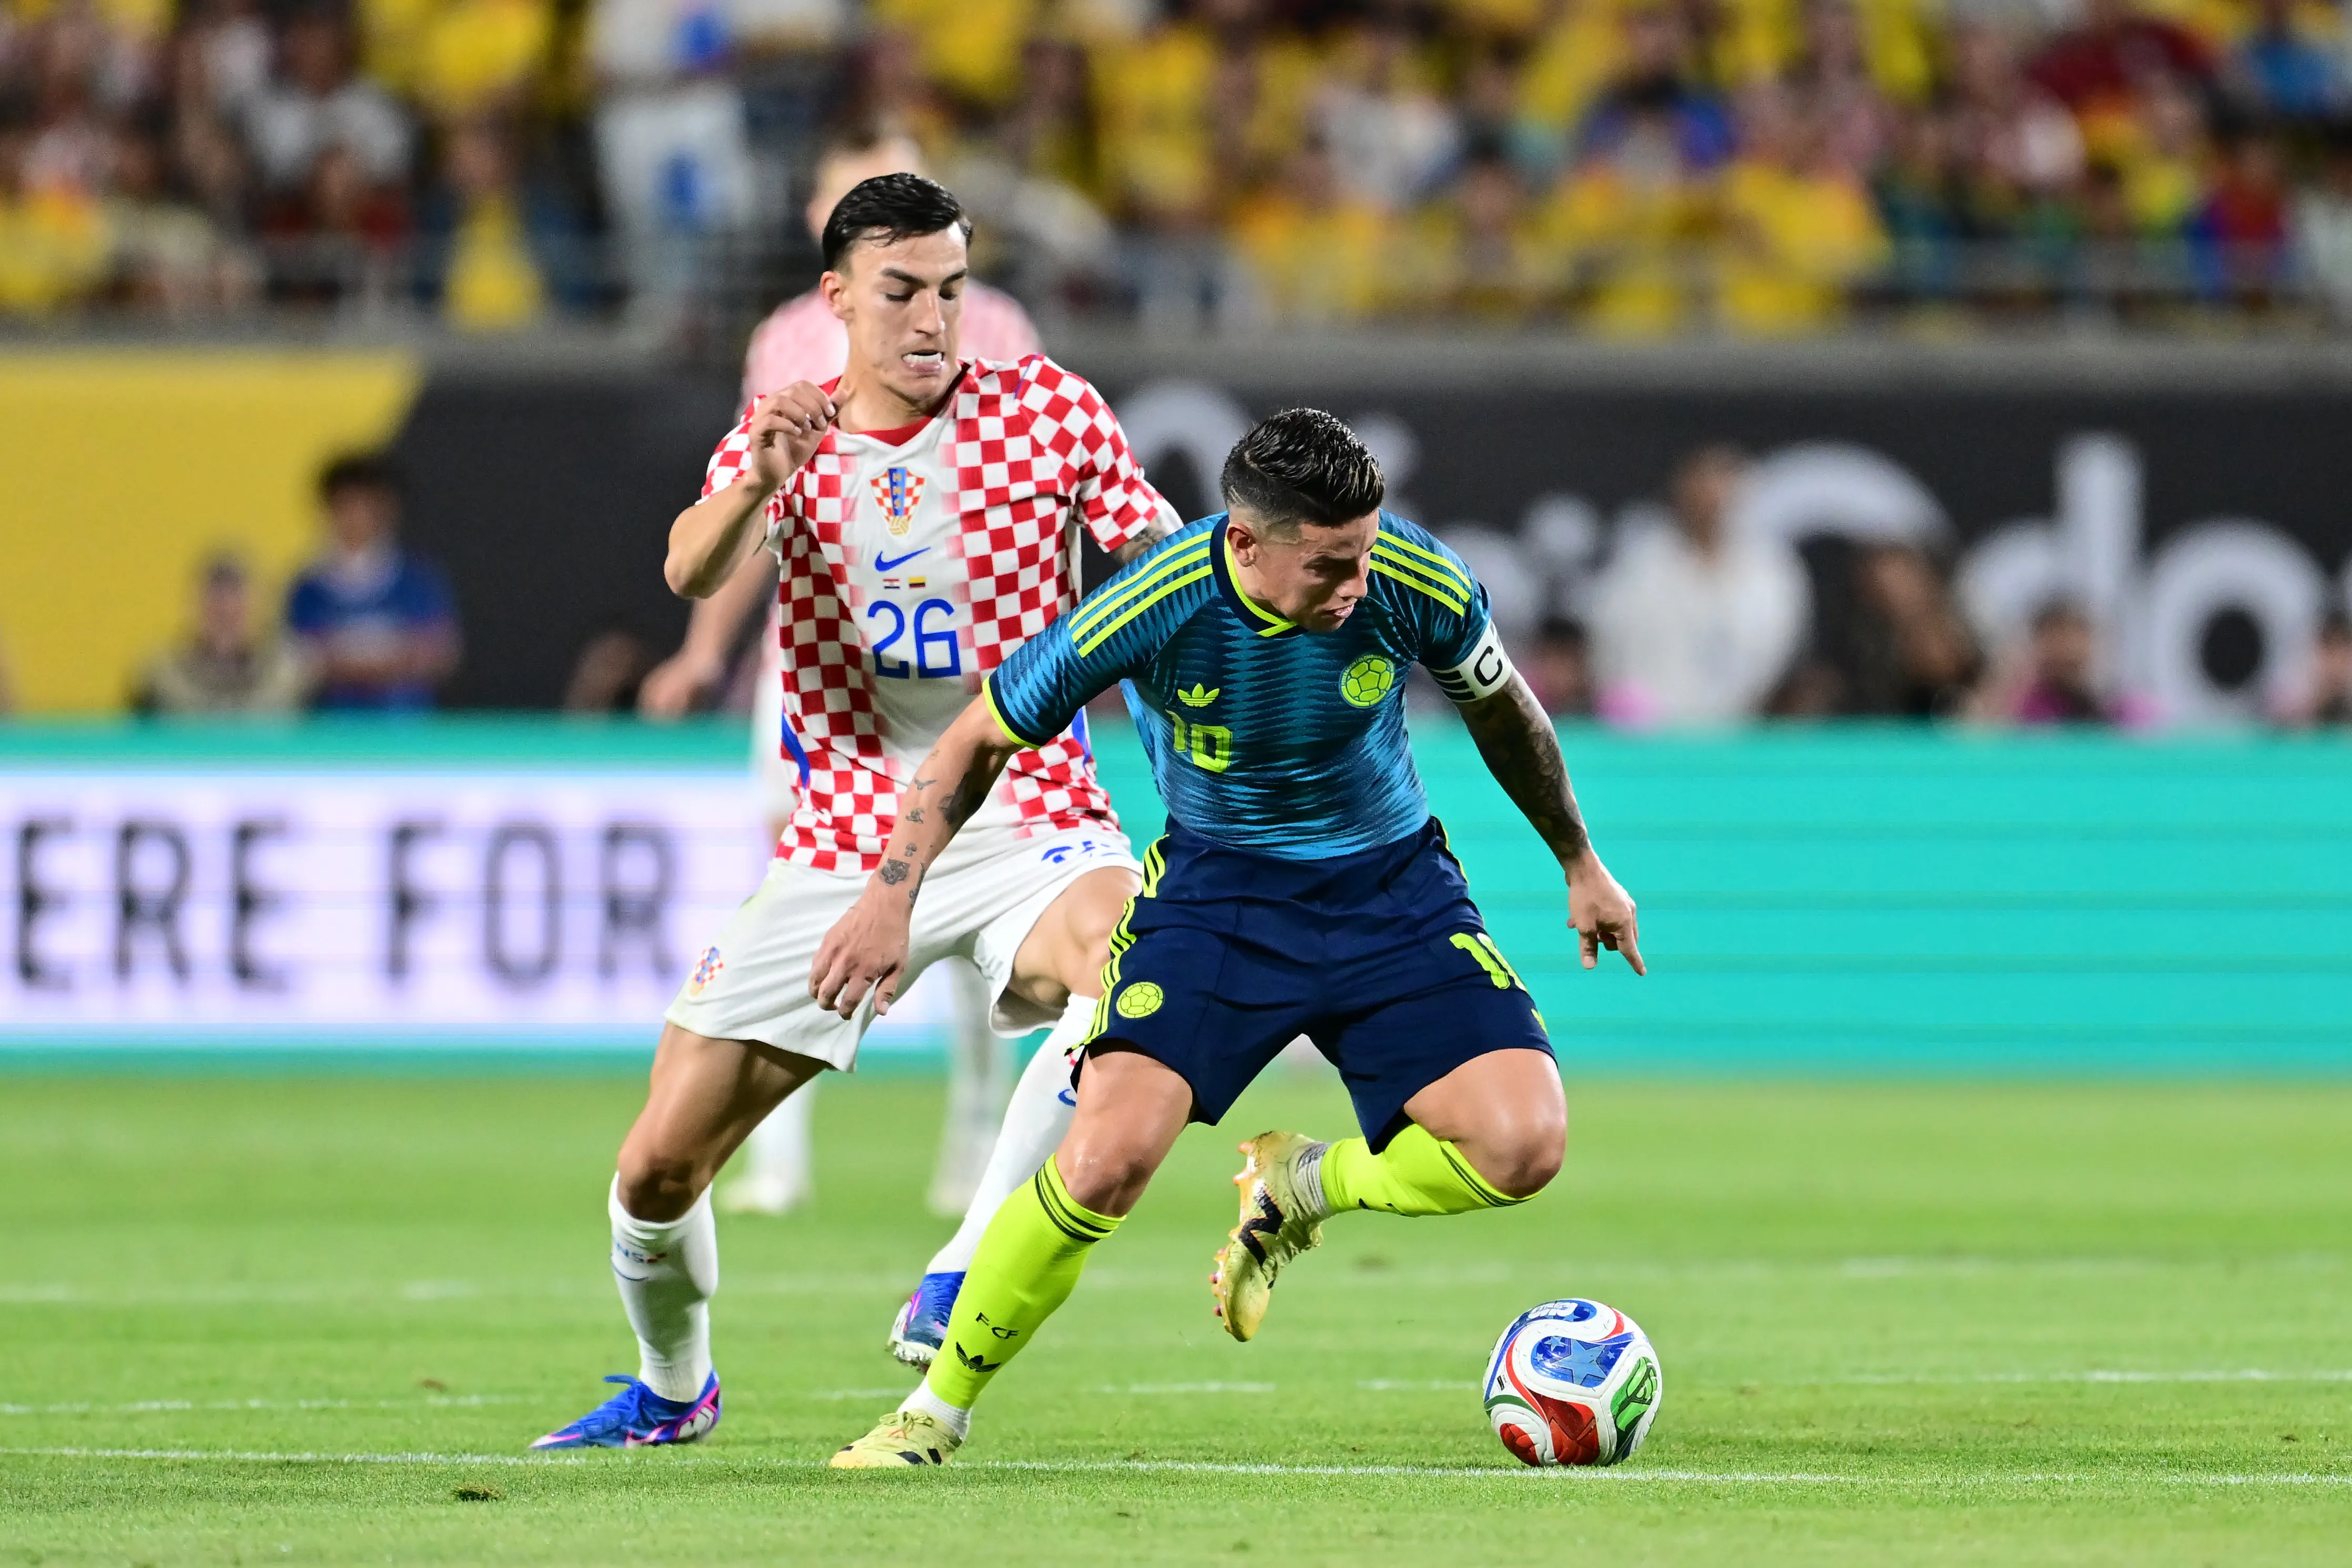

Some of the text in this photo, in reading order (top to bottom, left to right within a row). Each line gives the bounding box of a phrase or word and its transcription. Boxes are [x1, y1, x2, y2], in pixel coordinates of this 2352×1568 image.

[868, 598, 961, 679] 26
[1474, 646, 1503, 687] C
[1165, 708, 1233, 773] 10
[15, 814, 684, 995] ERE FOR
